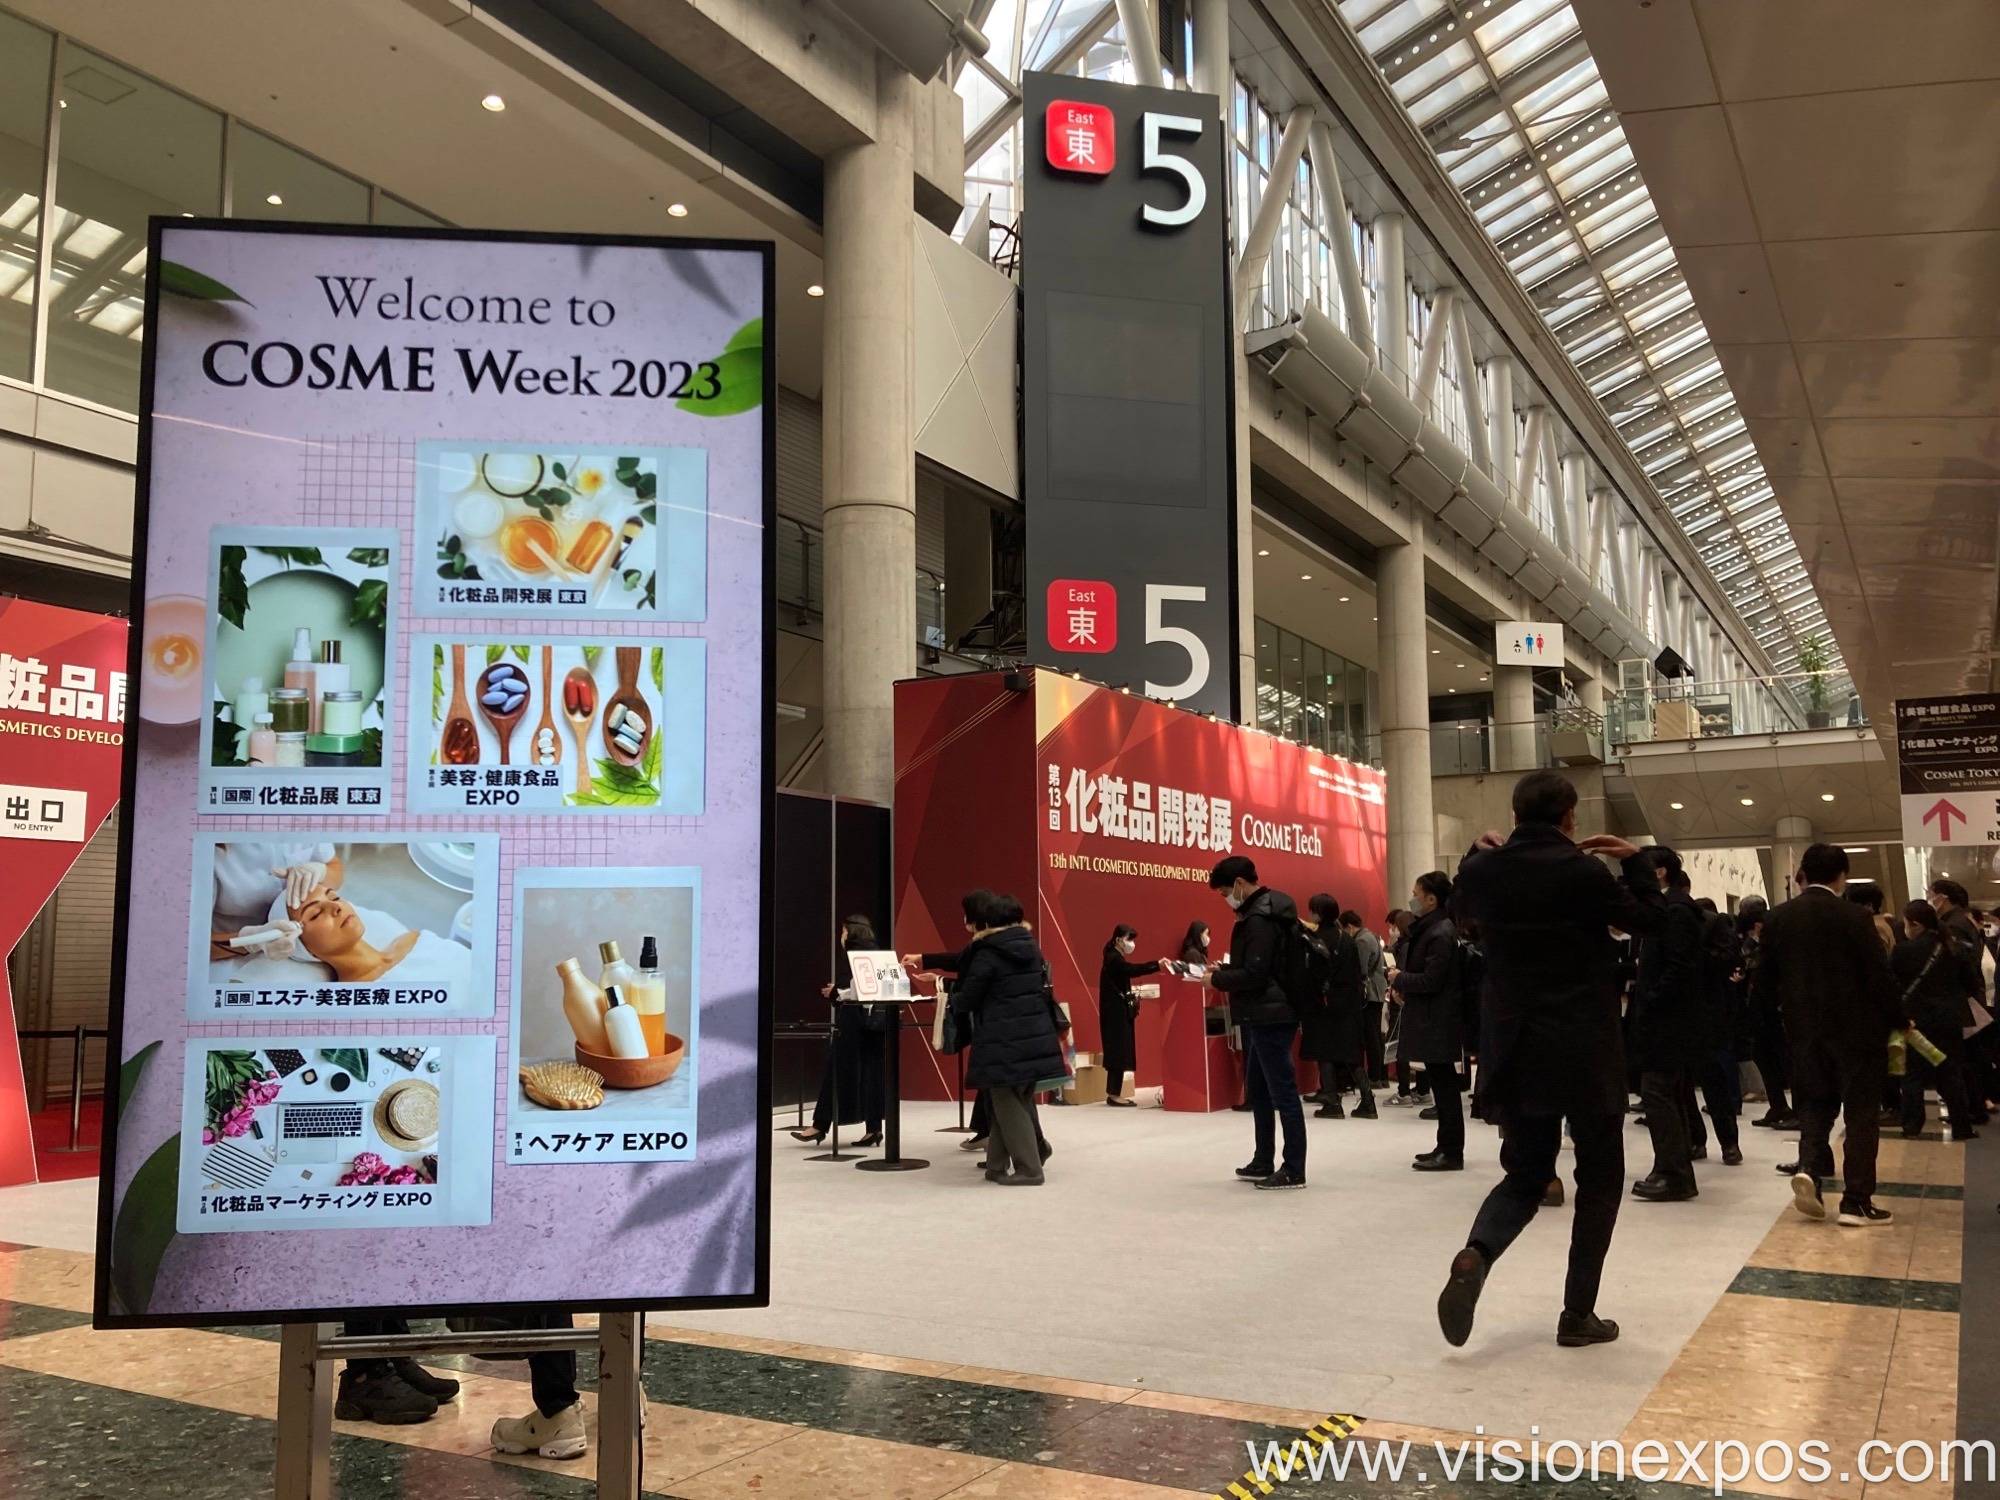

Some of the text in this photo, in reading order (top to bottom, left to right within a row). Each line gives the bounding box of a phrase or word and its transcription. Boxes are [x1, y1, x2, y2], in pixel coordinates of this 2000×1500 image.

[1068, 109, 1094, 125] East
[1065, 128, 1095, 165] 東
[1143, 111, 1207, 226] 5
[315, 275, 616, 328] Welcome to
[201, 339, 723, 400] COSME Week 2023
[448, 587, 553, 603] 化粧品開発展
[1068, 588, 1096, 603] East
[1066, 607, 1097, 646] 東
[1144, 584, 1210, 701] 5
[1924, 769, 1965, 780] COSME
[6, 795, 64, 823] 出口
[258, 786, 339, 805] 化粧品展
[347, 787, 381, 805] 東京
[466, 790, 520, 805] EXPO
[1048, 763, 1061, 831] 第13回
[1065, 767, 1232, 854] 化粧品開発展
[14, 822, 54, 832] NO ENTRY
[1241, 813, 1323, 857] COSME Tech
[1049, 852, 1209, 883] 13th INT'L COSMETICS DEVELOPMENT EXPO
[394, 989, 448, 1004] EXPO
[529, 1133, 615, 1152] ヘアケア
[623, 1132, 688, 1150] EXPO
[211, 1191, 380, 1213] 化粧品マーケティング
[383, 1191, 432, 1207] EXPO
